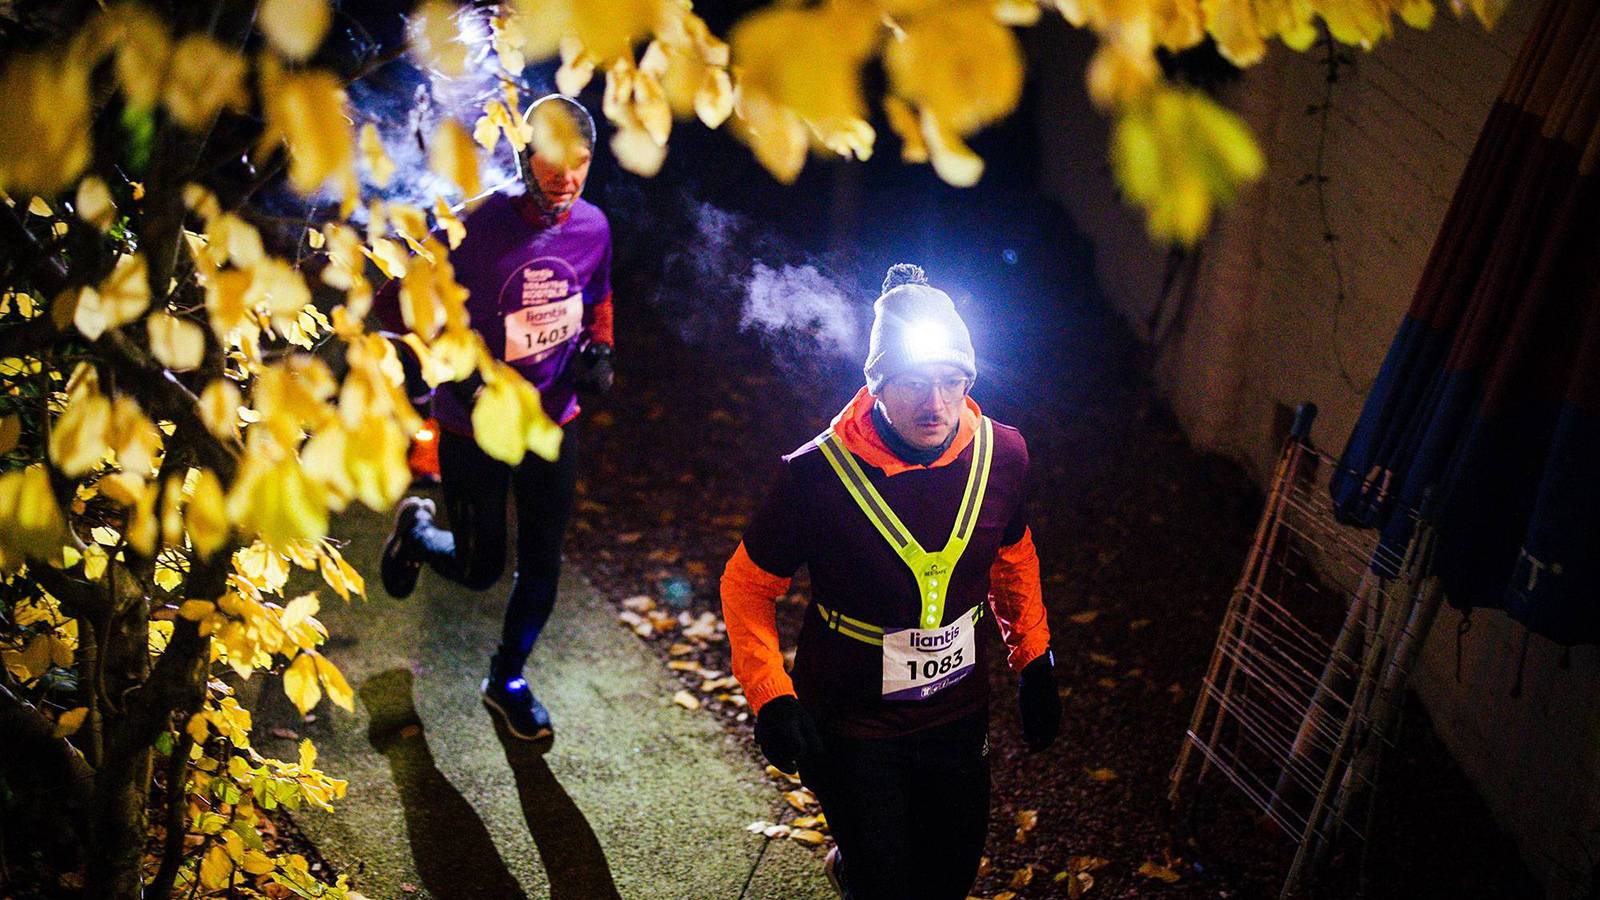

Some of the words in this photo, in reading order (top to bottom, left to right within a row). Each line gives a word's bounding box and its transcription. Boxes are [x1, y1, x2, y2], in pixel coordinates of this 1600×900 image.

[526, 308, 567, 321] liantis
[525, 325, 568, 349] 1403
[910, 626, 960, 647] liantis
[907, 647, 964, 681] 1083
